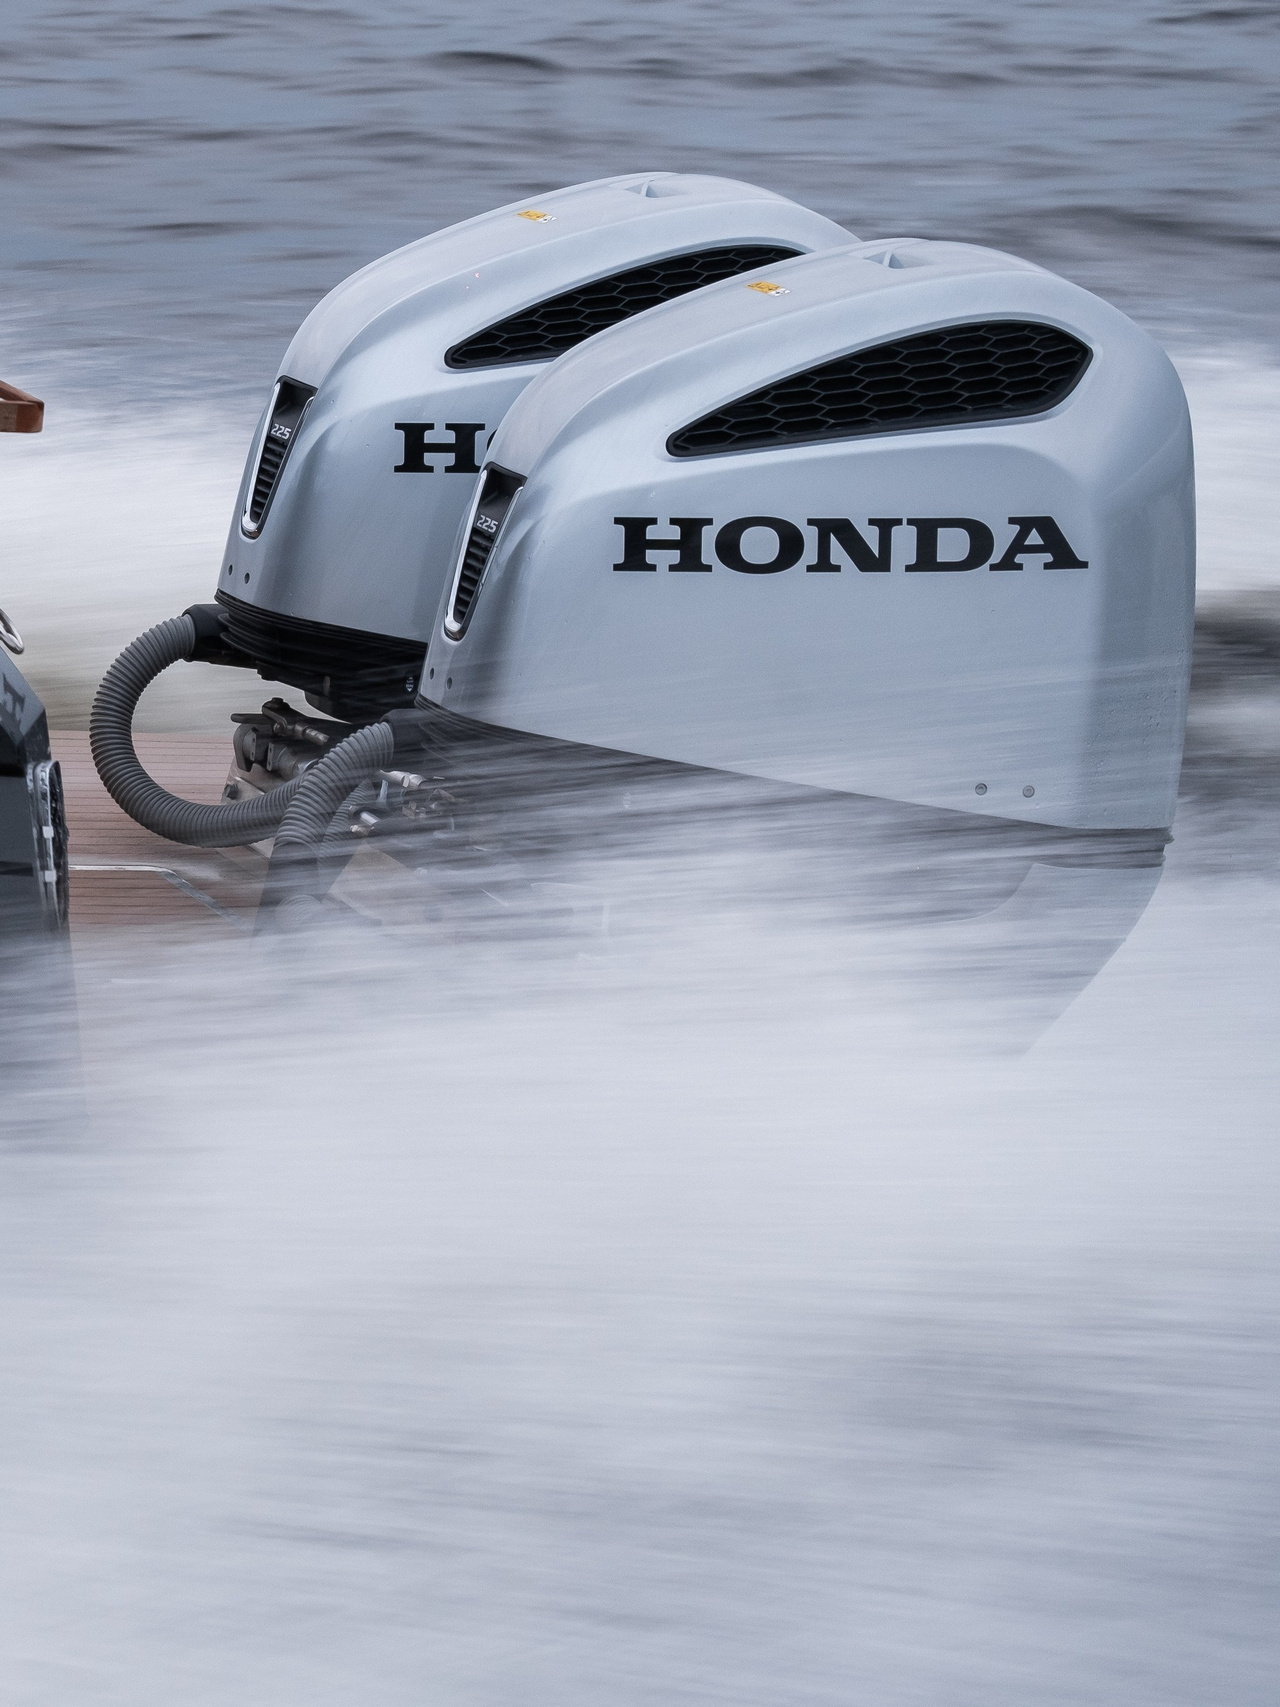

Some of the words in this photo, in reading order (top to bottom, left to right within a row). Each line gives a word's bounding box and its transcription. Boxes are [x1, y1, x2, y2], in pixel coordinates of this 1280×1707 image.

[271, 423, 292, 440] 225
[393, 422, 498, 474] H
[476, 514, 499, 533] 225
[613, 515, 1089, 574] HONDA
